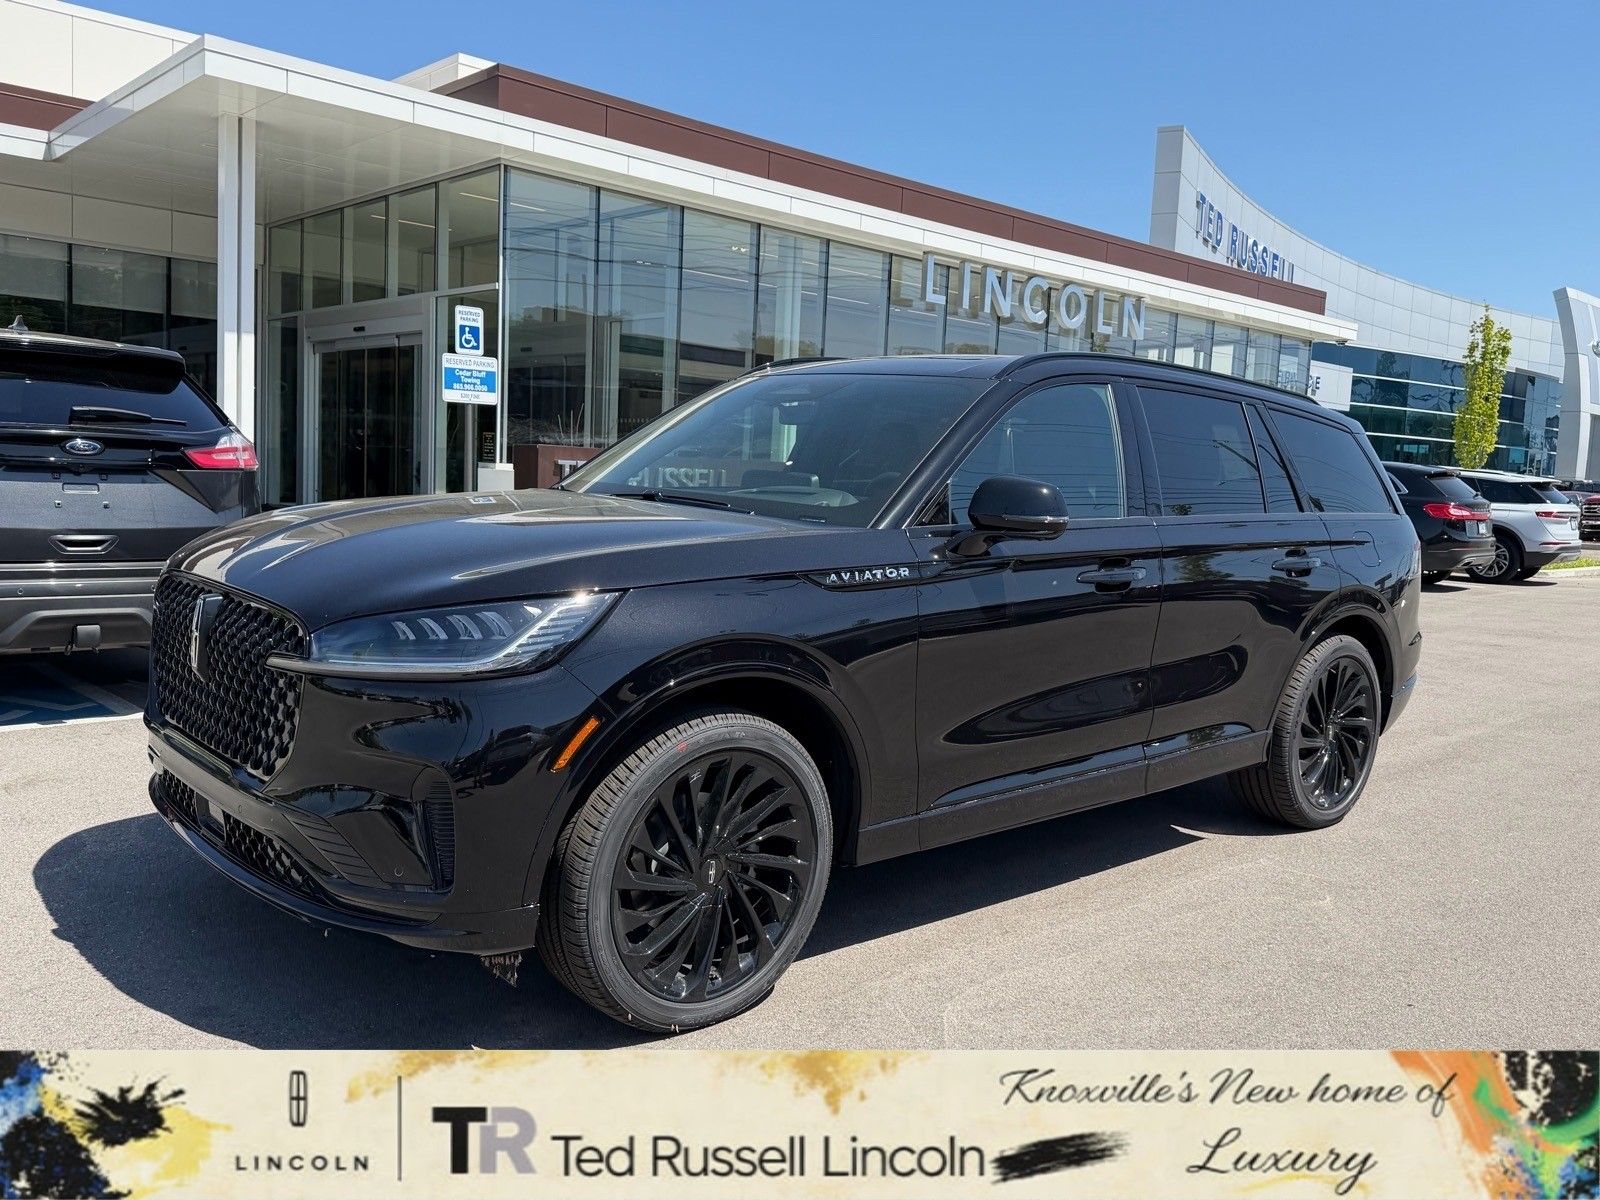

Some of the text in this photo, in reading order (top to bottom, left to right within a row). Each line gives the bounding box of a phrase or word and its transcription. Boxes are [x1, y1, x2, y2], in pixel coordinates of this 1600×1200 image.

[1196, 191, 1223, 248] TED
[922, 251, 1145, 340] LINCOLN
[458, 309, 481, 318] RESERVED
[445, 357, 495, 369] RESERVED PARKING
[461, 376, 480, 384] Towing
[829, 567, 910, 583] AVIATOR
